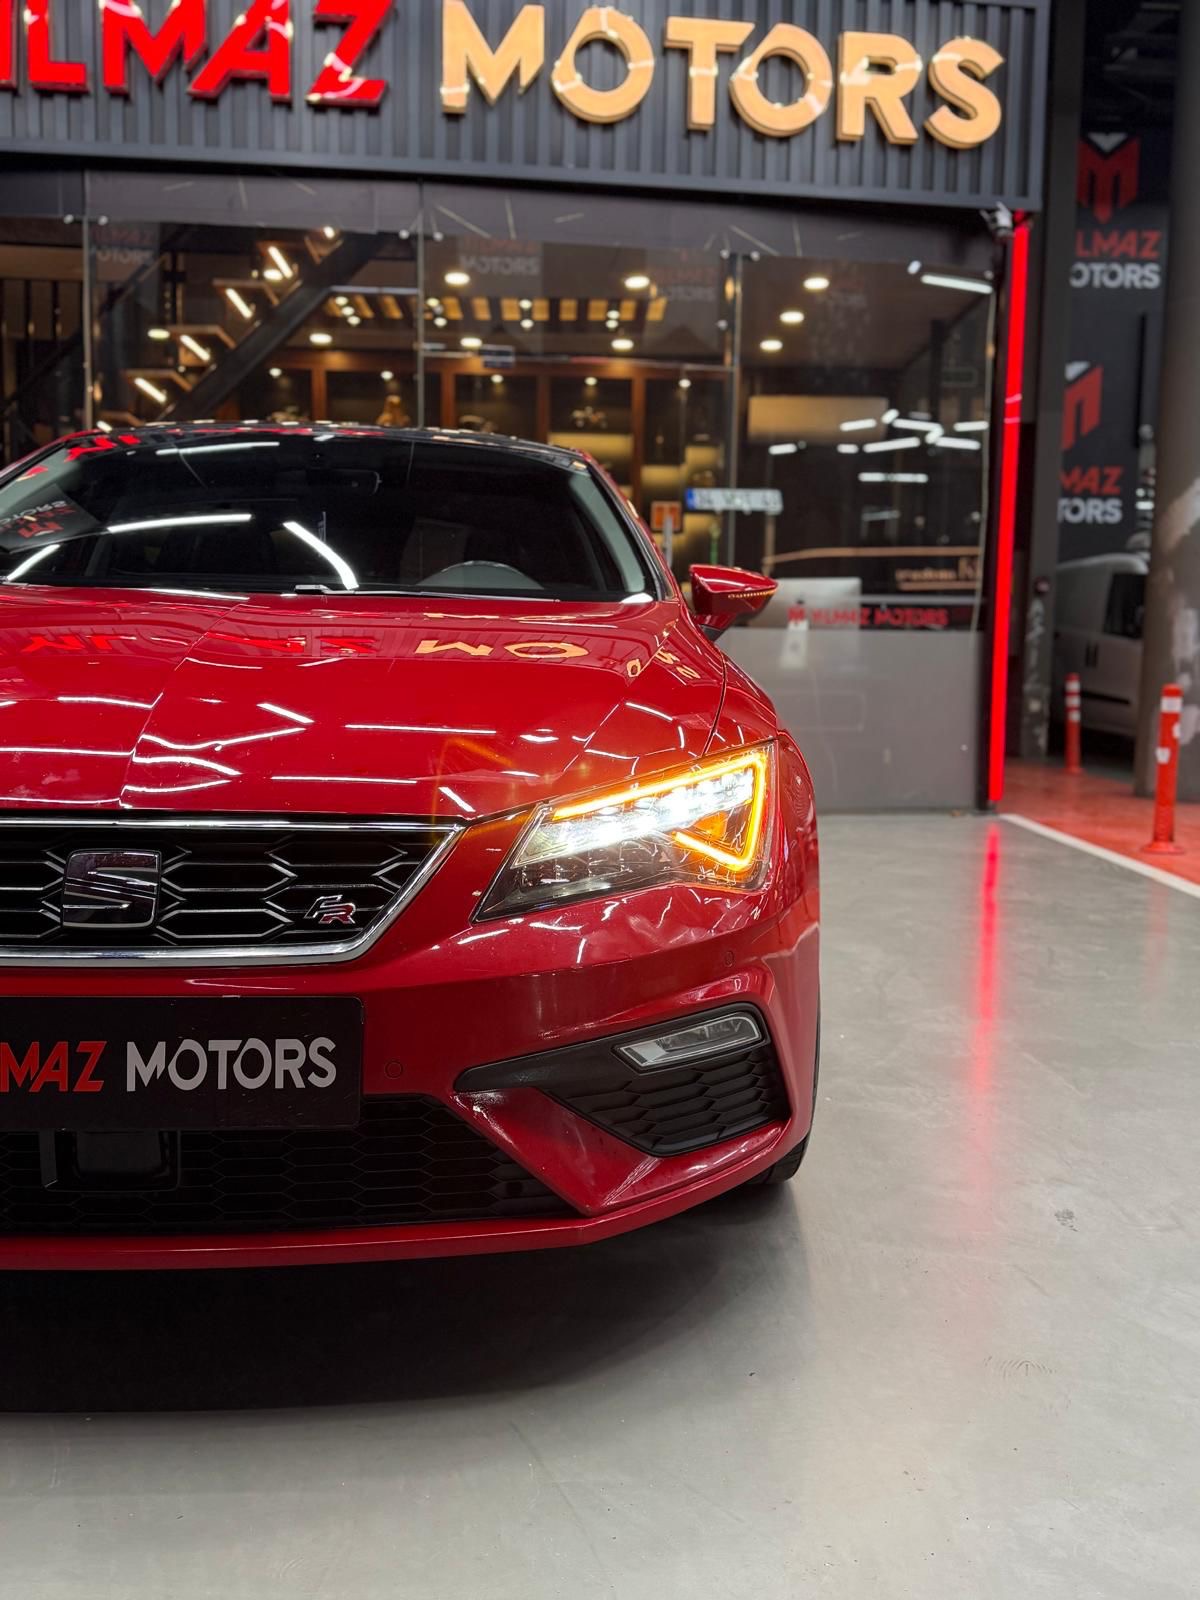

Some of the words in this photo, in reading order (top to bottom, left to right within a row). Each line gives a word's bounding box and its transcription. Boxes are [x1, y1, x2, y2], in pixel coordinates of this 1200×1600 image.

[441, 0, 1005, 150] MOTORS
[303, 894, 357, 925] FR
[0, 1040, 107, 1093] MAZ
[126, 1037, 337, 1093] MOTORS
